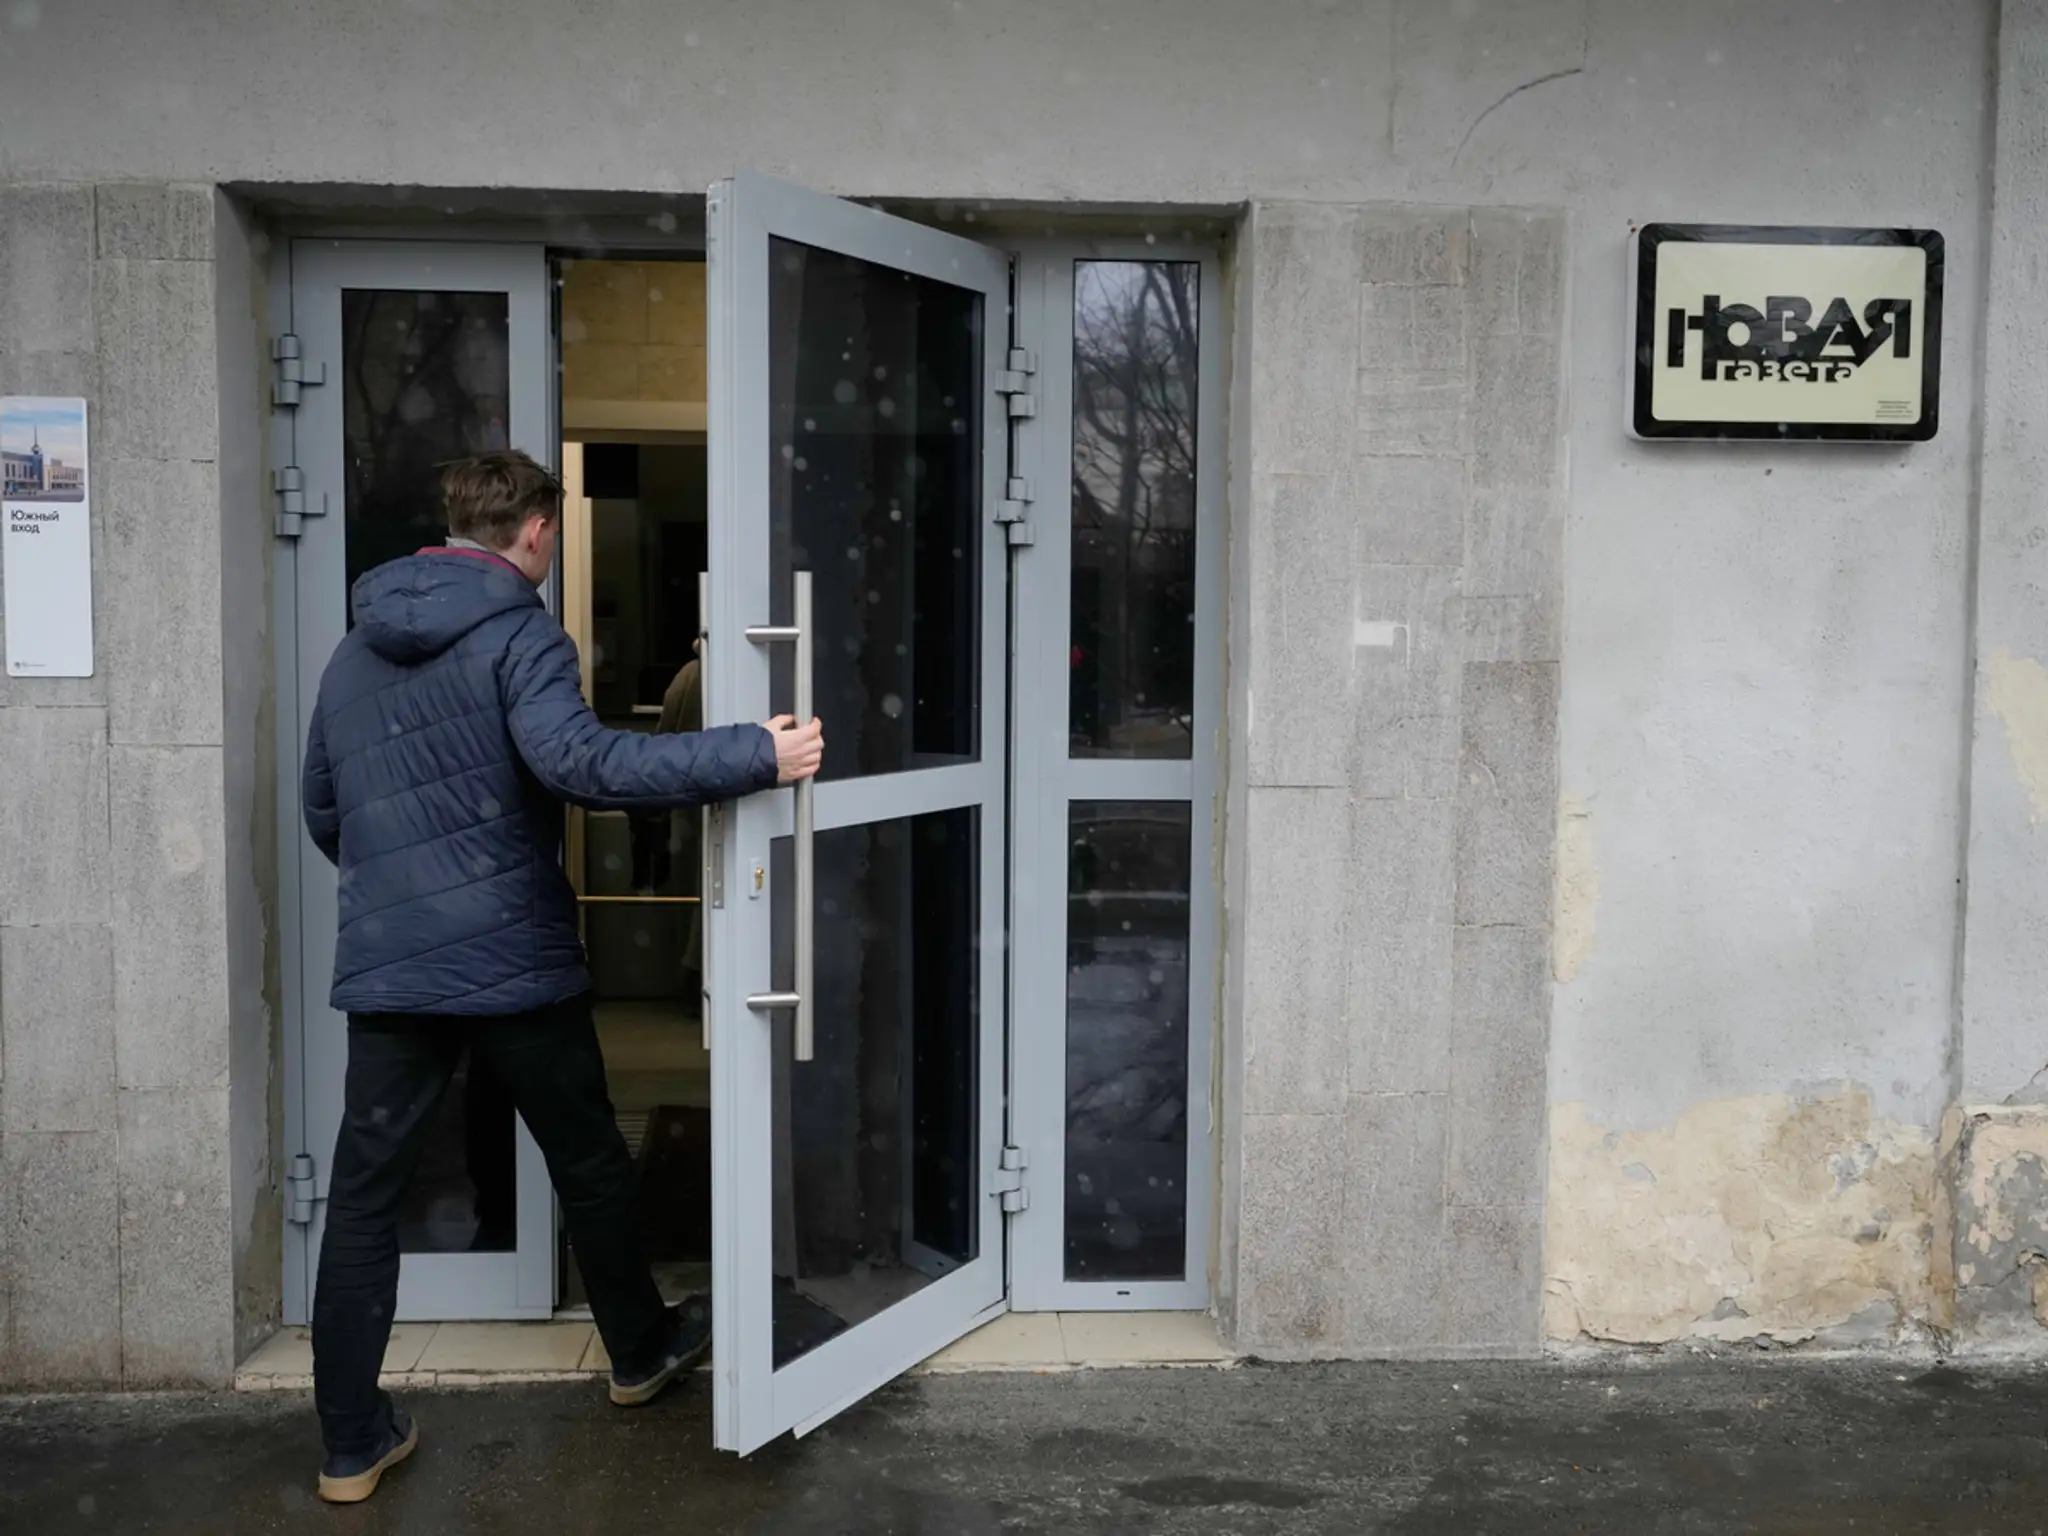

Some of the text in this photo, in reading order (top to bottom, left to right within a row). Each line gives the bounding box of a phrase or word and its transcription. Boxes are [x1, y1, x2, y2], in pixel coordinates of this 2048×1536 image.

[1667, 295, 1912, 381] НОВАЯ
[1715, 359, 1854, 383] газета
[11, 509, 60, 521] Южный
[11, 524, 40, 534] вход
